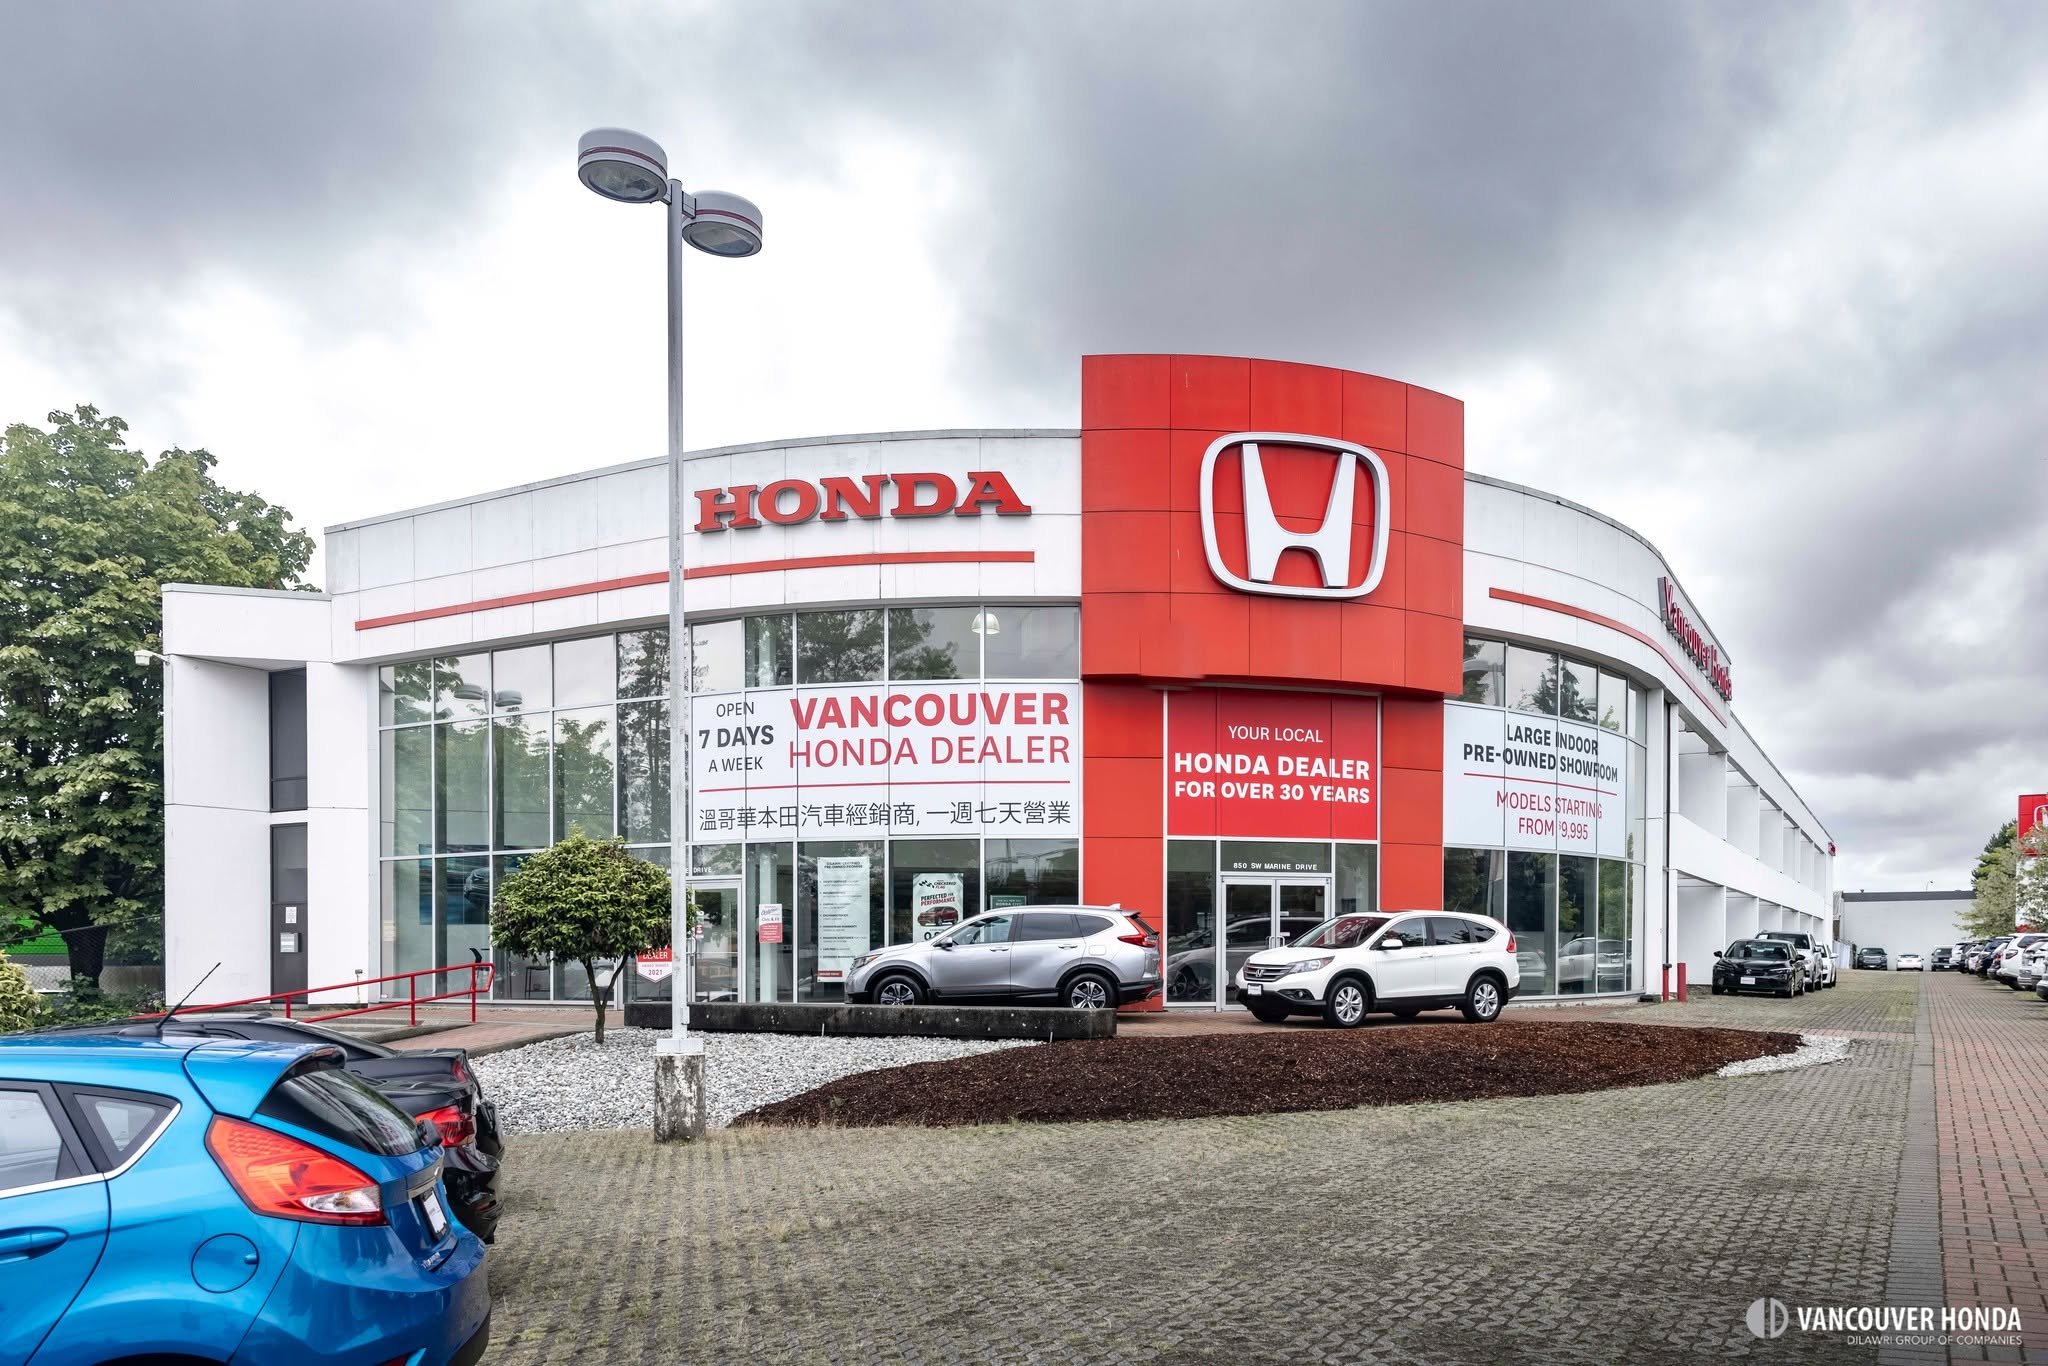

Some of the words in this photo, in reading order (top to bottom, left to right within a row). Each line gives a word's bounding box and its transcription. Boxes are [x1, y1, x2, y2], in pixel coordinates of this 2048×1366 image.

[694, 471, 1032, 533] HONDA
[716, 701, 755, 717] OPEN
[789, 693, 1069, 730] VANCOUVER
[698, 729, 710, 749] 7
[717, 725, 774, 748] DAYS
[1228, 726, 1270, 741] YOUR
[1274, 728, 1323, 743] LOCAL
[1507, 724, 1551, 747] LARGE
[1555, 731, 1598, 756] INDOOR
[789, 737, 918, 769] HONDA
[931, 735, 1070, 764] DEALER
[1463, 743, 1556, 770] PRE-OWNED
[1559, 756, 1618, 783] SHOWROOM
[708, 759, 718, 773] A
[721, 756, 763, 772] WEEK
[1174, 752, 1270, 776] HONDA
[1277, 756, 1370, 781] DEALER
[1174, 781, 1216, 798] FOR
[1220, 782, 1274, 800] OVER
[1279, 784, 1304, 801] 30
[1309, 785, 1370, 804] YEARS
[1496, 790, 1551, 812] MODELS
[1555, 797, 1602, 819] STARTING
[1518, 817, 1554, 836] FROM
[1295, 863, 1318, 871] DRIVE
[920, 893, 948, 901] PERFECTED
[920, 897, 956, 907] PERFORMANCE
